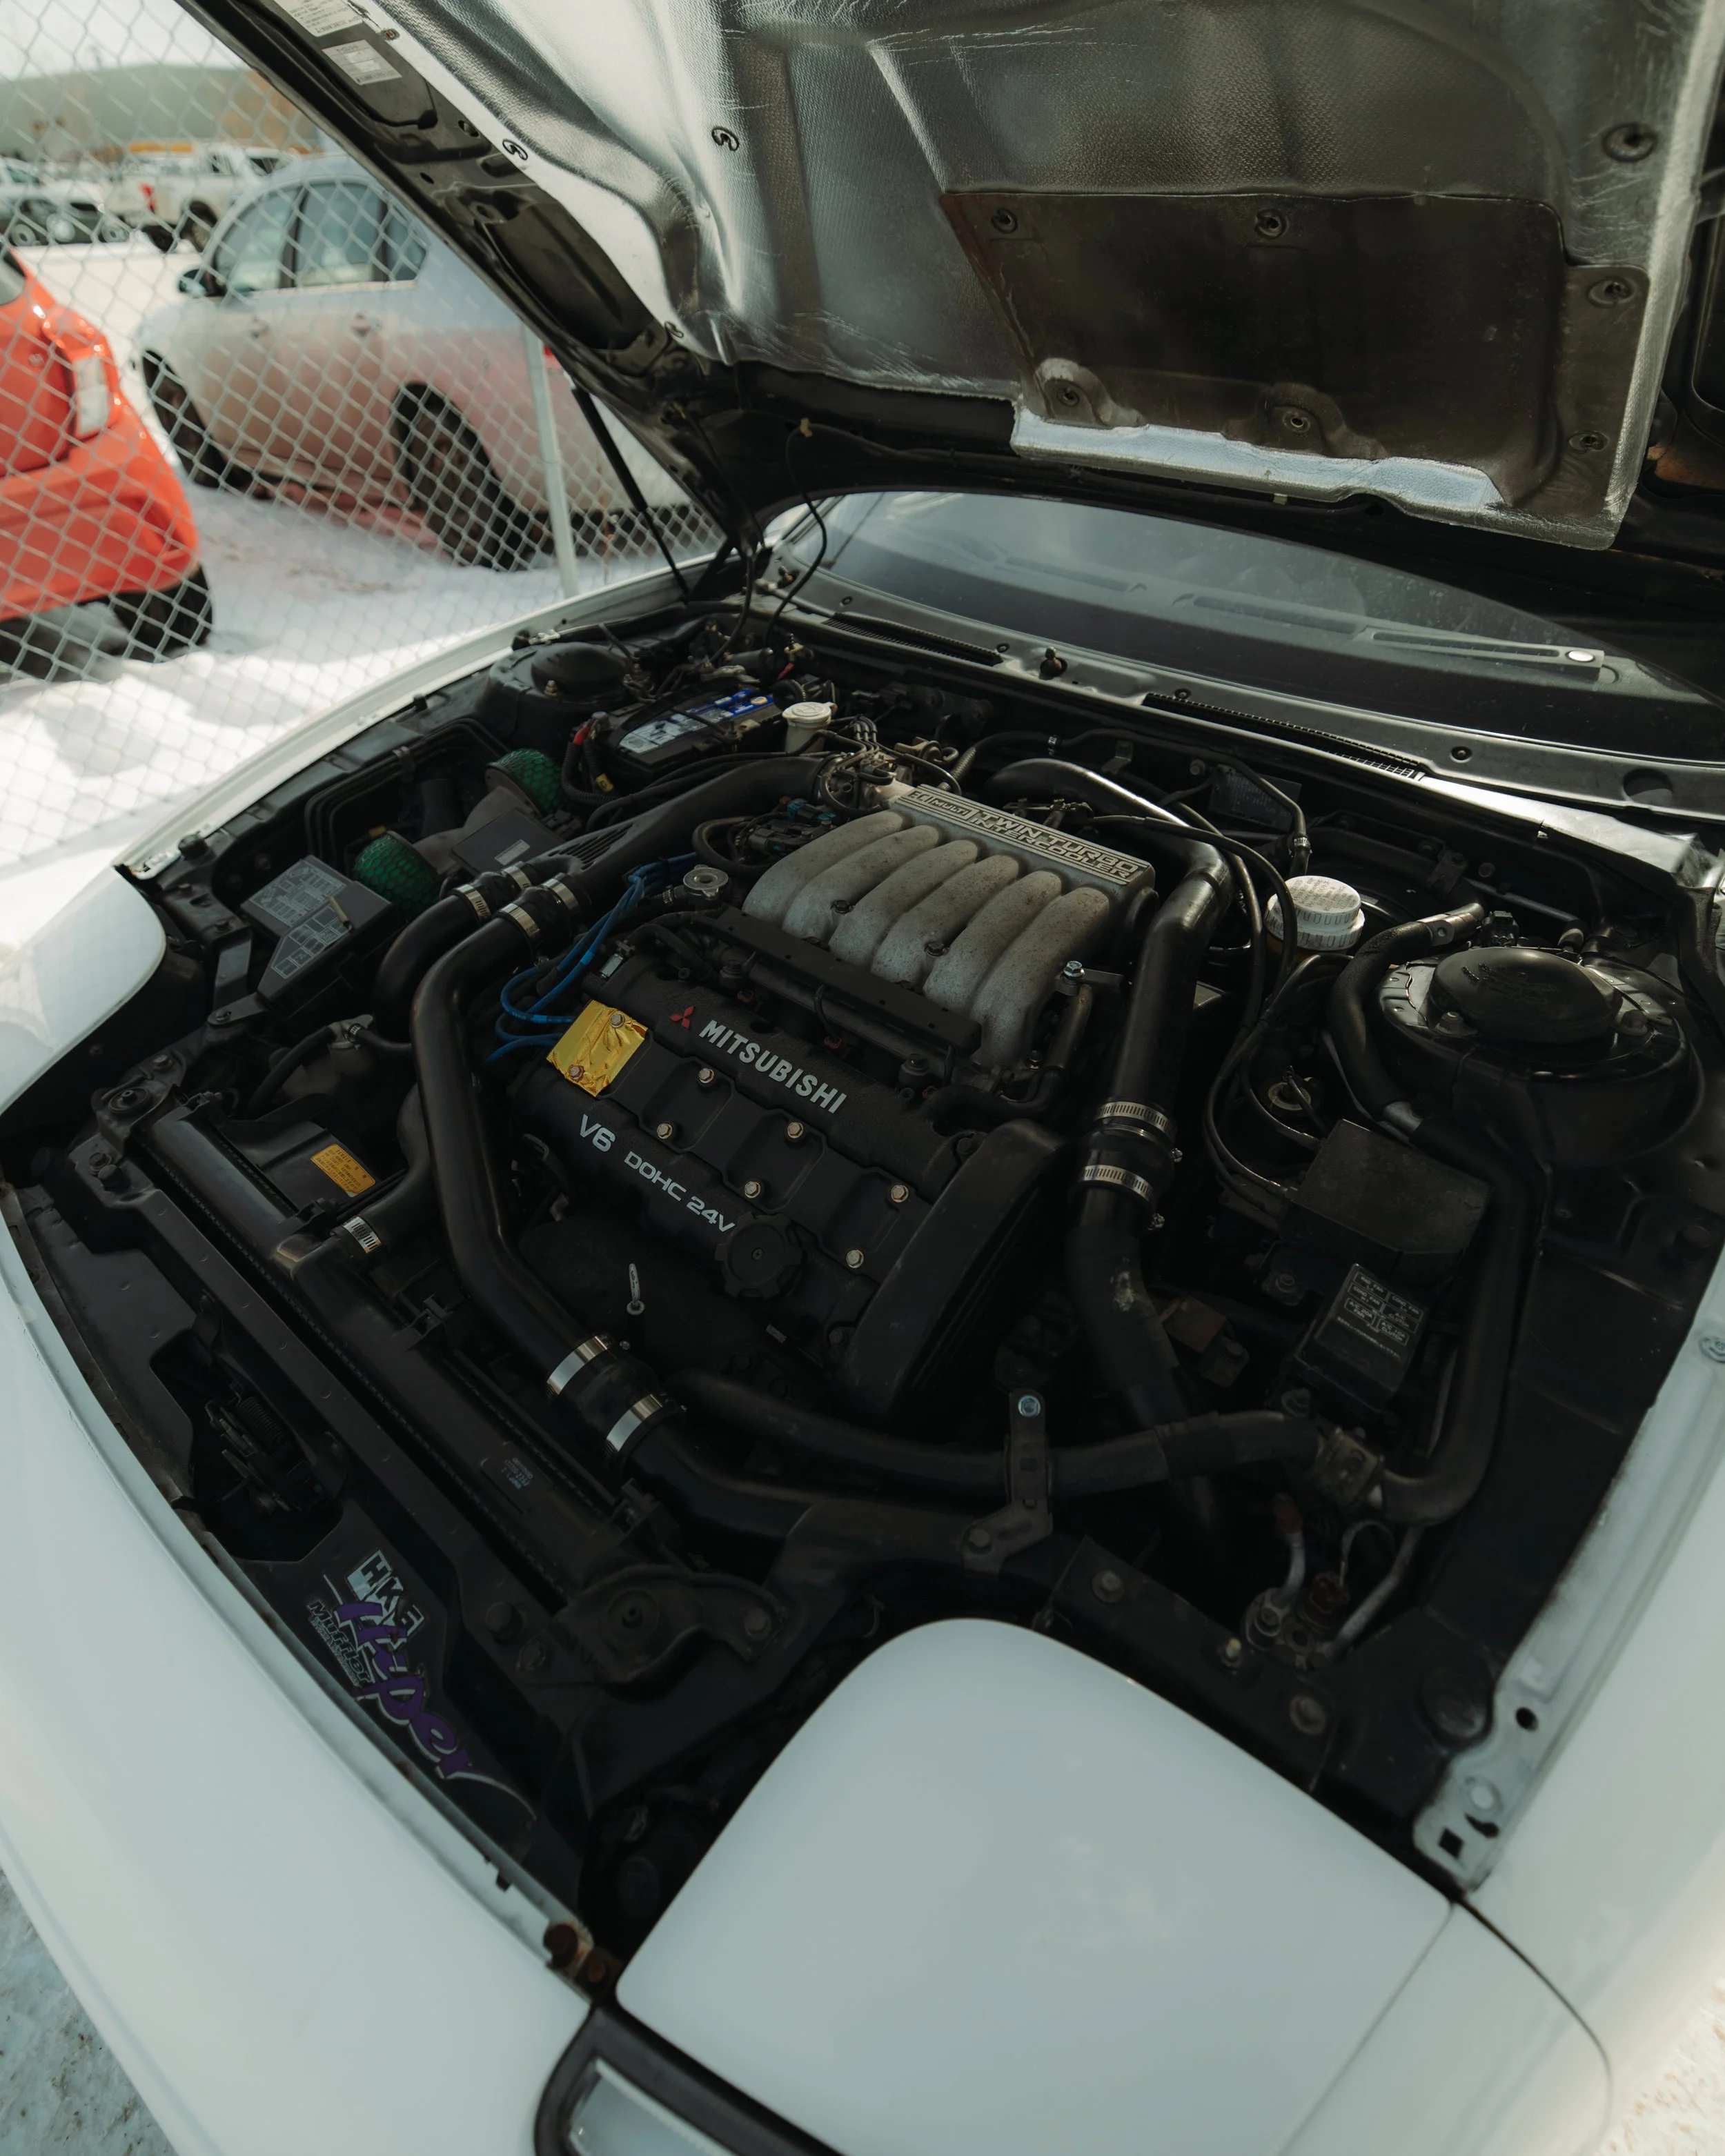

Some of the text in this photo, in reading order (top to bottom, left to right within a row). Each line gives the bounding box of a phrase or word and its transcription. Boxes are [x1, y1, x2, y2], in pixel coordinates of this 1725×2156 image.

[907, 790, 933, 802] ECI
[931, 799, 969, 815] MULTI
[969, 818, 1130, 879] INTERCOOLER
[982, 811, 1139, 875] TWIN TURBO
[698, 1020, 848, 1114] MITSUBISHI
[579, 1114, 736, 1233] V6 DOHC 24V
[1373, 1284, 1384, 1293] FAN
[1349, 1301, 1360, 1311] A/C
[1370, 1296, 1380, 1306] FAN
[1353, 1309, 1365, 1318] FAN
[1394, 1312, 1406, 1321] A/C
[1408, 1305, 1419, 1314] FAN
[1381, 1321, 1392, 1330] A/C
[1388, 1314, 1410, 1328] CLUTCH
[1381, 1327, 1403, 1342] CLUTCH
[307, 1600, 373, 1683] Muffler
[333, 1601, 498, 1786] Hiper
